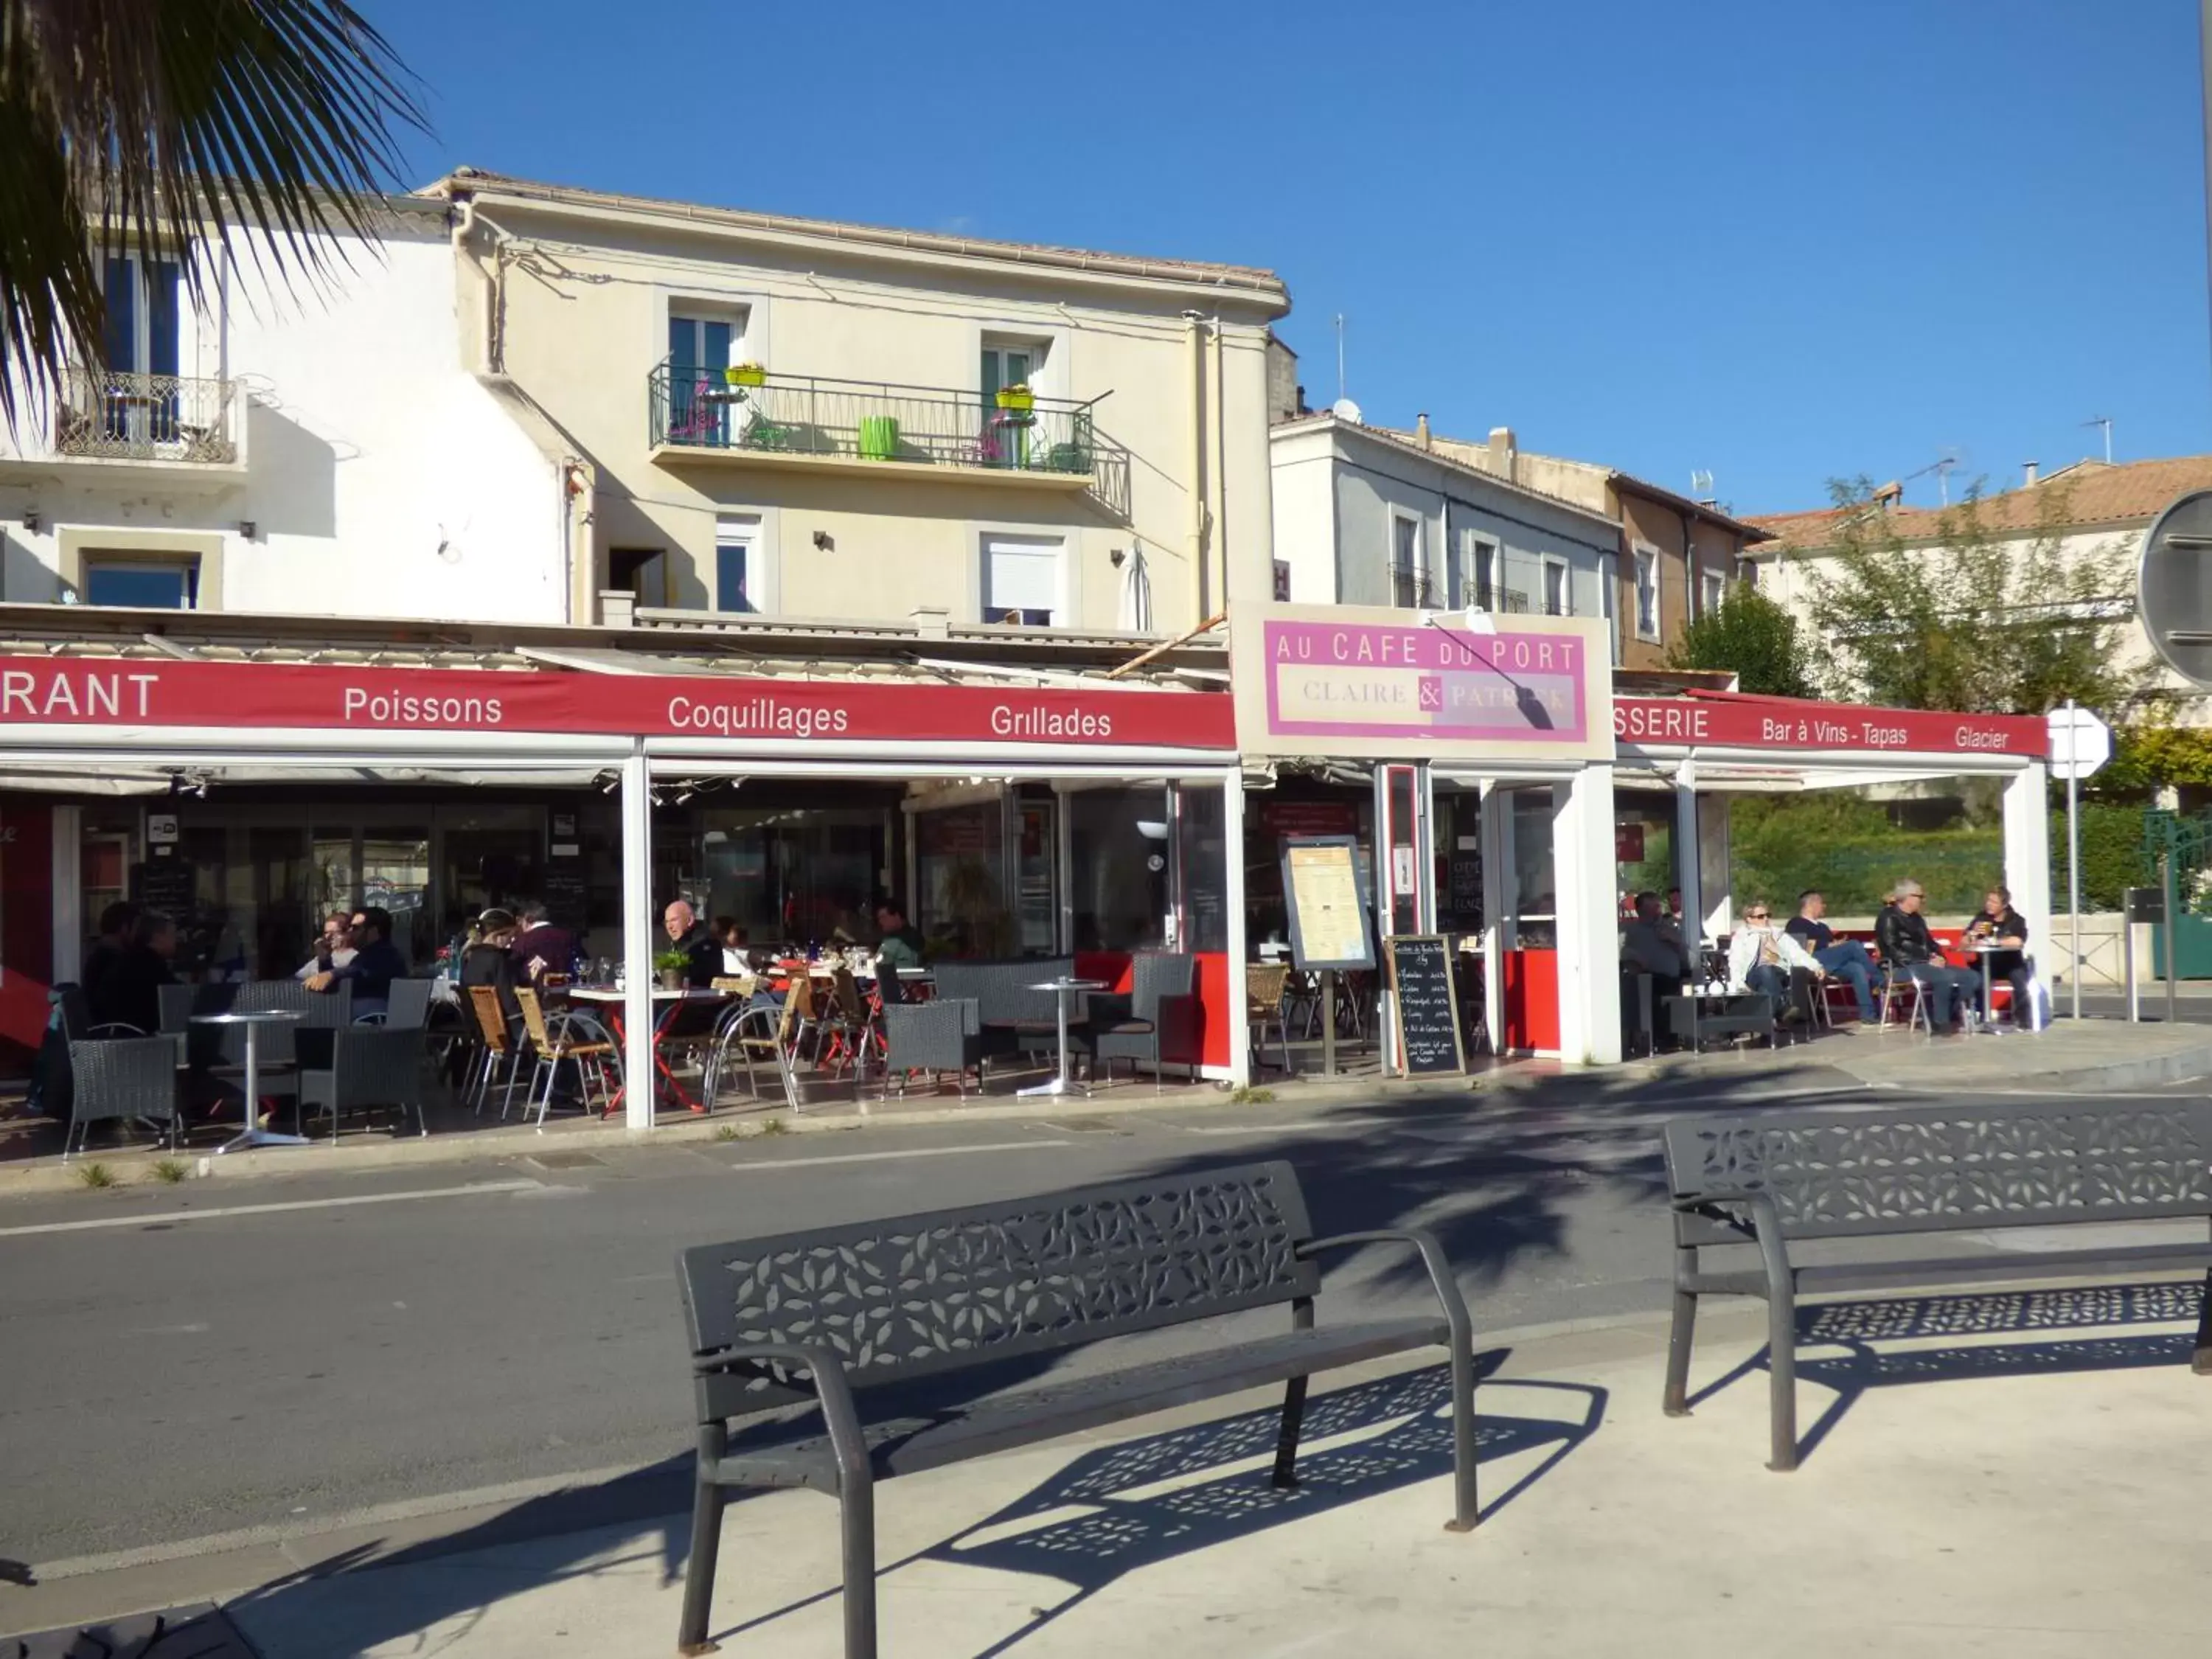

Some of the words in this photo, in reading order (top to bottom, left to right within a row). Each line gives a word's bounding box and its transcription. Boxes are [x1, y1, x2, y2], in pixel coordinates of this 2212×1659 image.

[1277, 635, 1311, 658] AU
[1333, 633, 1417, 664] CAFE
[1440, 643, 1471, 666] DU
[1493, 641, 1574, 669] PORT
[3, 670, 160, 717] RANT
[344, 687, 503, 723] Poissons
[1303, 680, 1407, 703] CLAIRE
[1420, 681, 1441, 706] &
[668, 696, 848, 737] Coquillages
[990, 705, 1112, 737] Grillades
[1613, 706, 1709, 737] SSERIE
[1762, 717, 1792, 741] Bar
[1798, 718, 1808, 742] à
[1861, 722, 1908, 749] Tapas
[1955, 726, 2011, 749] Glacier
